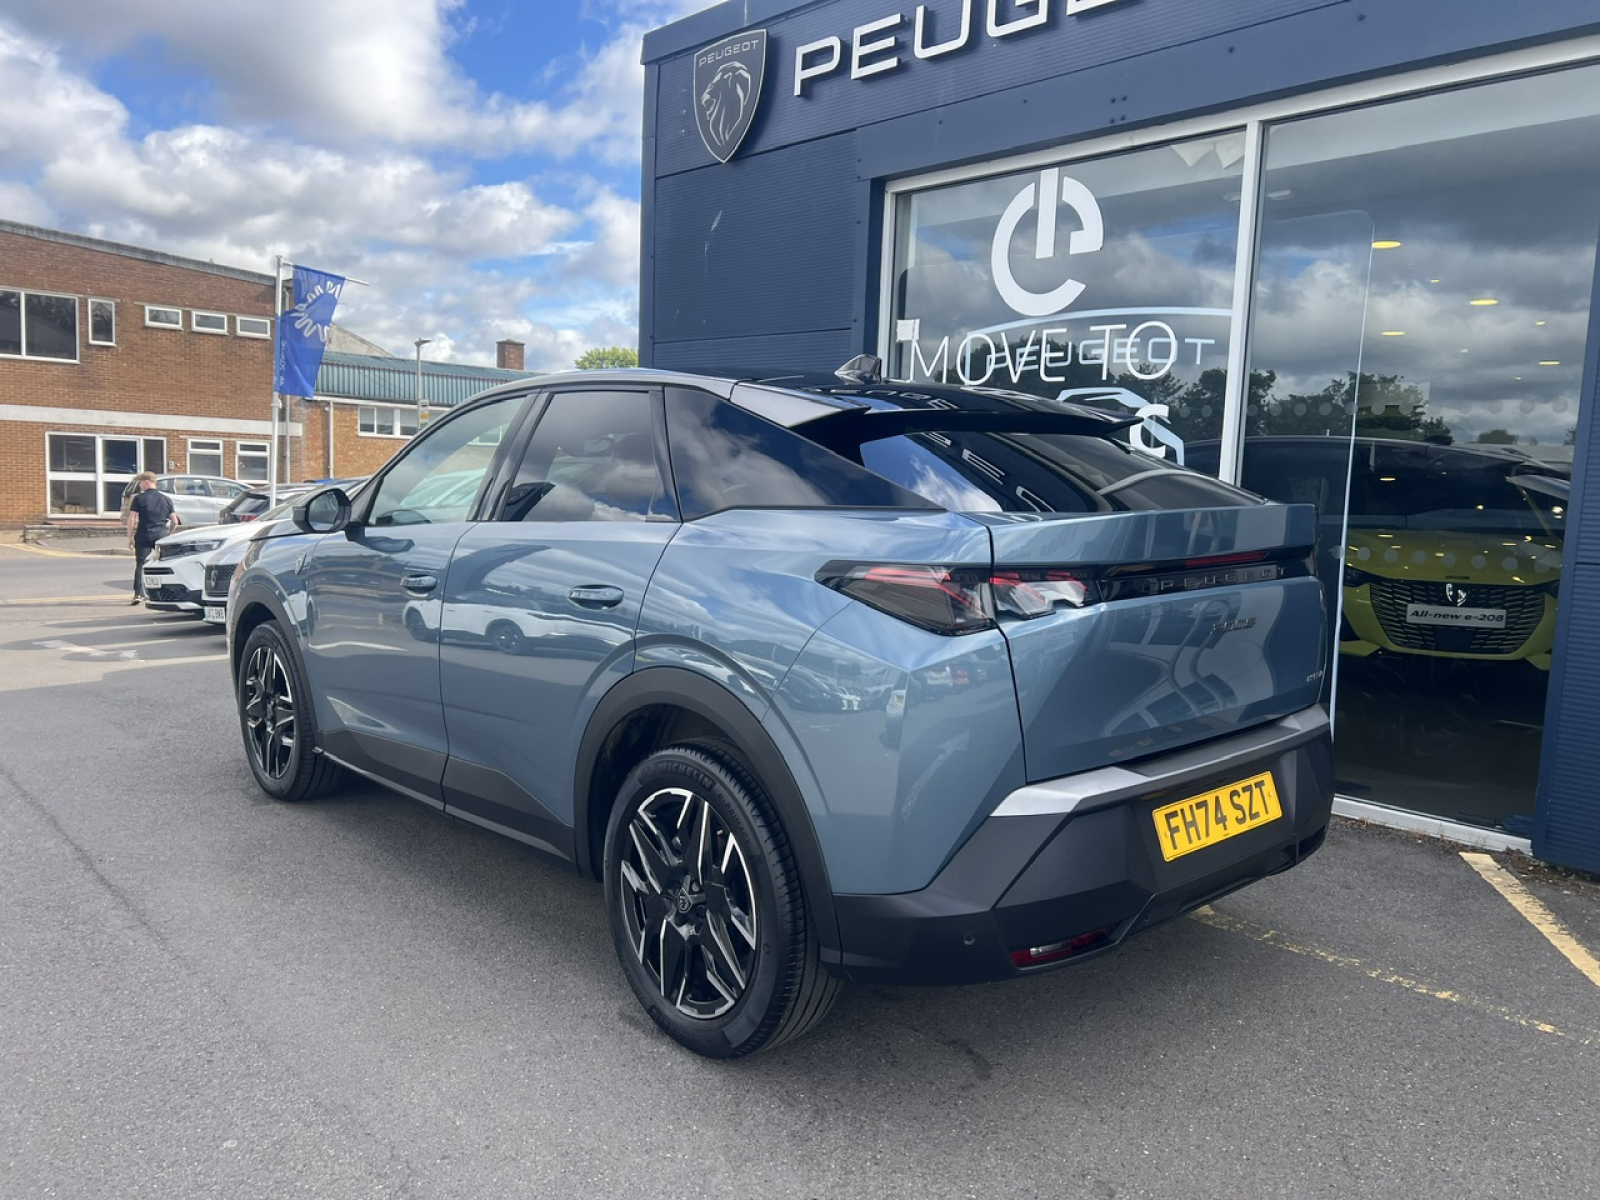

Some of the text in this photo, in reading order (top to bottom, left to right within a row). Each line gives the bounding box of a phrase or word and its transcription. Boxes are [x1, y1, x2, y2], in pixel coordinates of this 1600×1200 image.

[699, 40, 759, 68] PEUGEOT
[909, 320, 1178, 386] MOVE TO
[985, 337, 1216, 376] PEUGEOT
[1409, 610, 1505, 622] All-new e-208
[658, 762, 714, 791] MICHELIN
[1164, 780, 1270, 850] FH74 SZT
